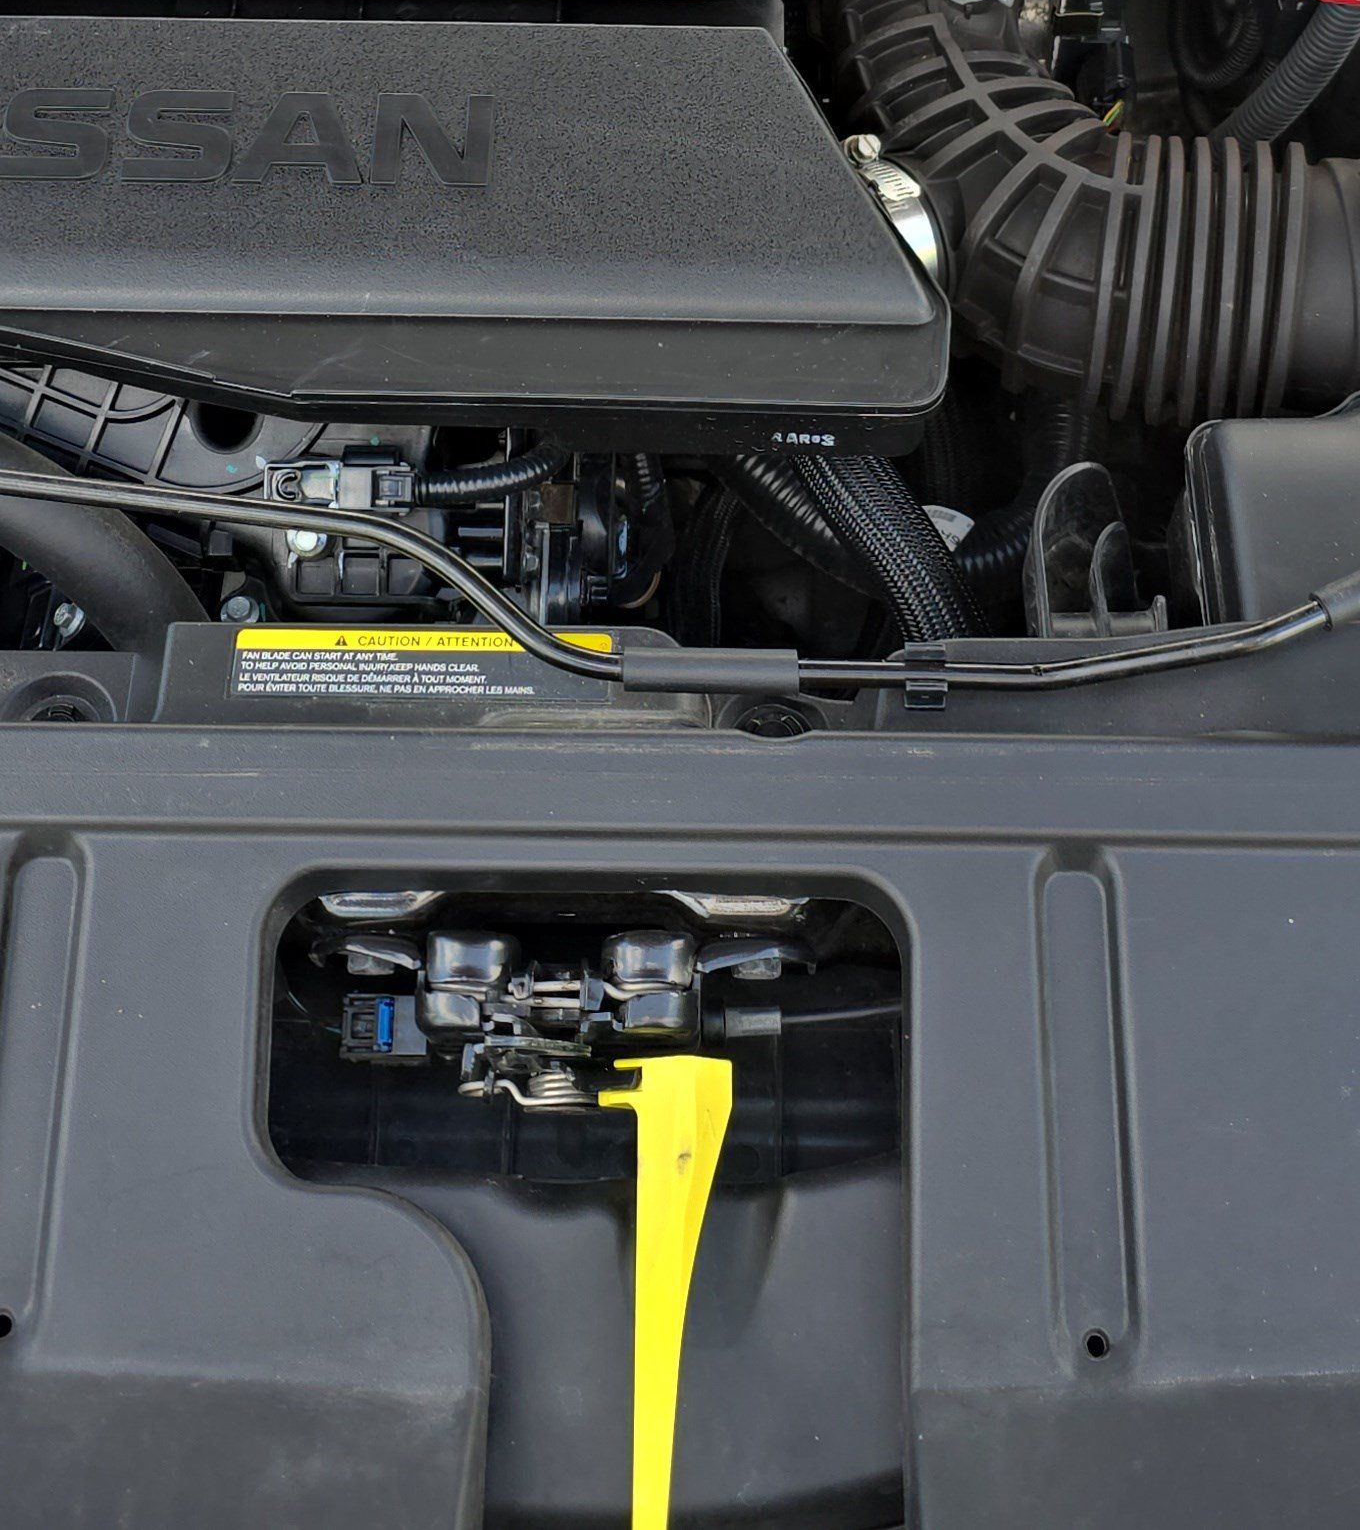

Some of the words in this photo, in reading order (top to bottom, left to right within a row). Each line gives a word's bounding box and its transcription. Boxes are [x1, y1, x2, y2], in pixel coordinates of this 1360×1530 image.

[358, 636, 420, 646] CAUTION
[437, 636, 514, 647] ATTENTION
[242, 651, 260, 660] FAN
[261, 651, 291, 660] BLADE
[292, 651, 312, 660] CAN
[313, 652, 341, 660] START
[342, 652, 355, 660] AT
[355, 652, 374, 660] ANY
[241, 661, 254, 670] TO
[255, 661, 279, 670] HELP
[280, 662, 307, 670] AVOID
[308, 662, 357, 671] PERSONAL
[414, 663, 446, 671] HANDS
[239, 672, 250, 681] LE
[252, 672, 310, 681] VENTILATEUR
[311, 673, 346, 682] RISQUE
[347, 674, 360, 682] DE
[361, 672, 411, 683] DÉMARRER
[421, 675, 445, 683] TOUT
[238, 683, 264, 692] POUR
[265, 682, 296, 692] ÉVITER
[298, 684, 327, 692] TOUTE
[379, 685, 392, 693] NE
[393, 685, 412, 693] PAS
[413, 685, 426, 693] EN
[427, 685, 485, 694] APPROCHER
[485, 686, 503, 694] LES
